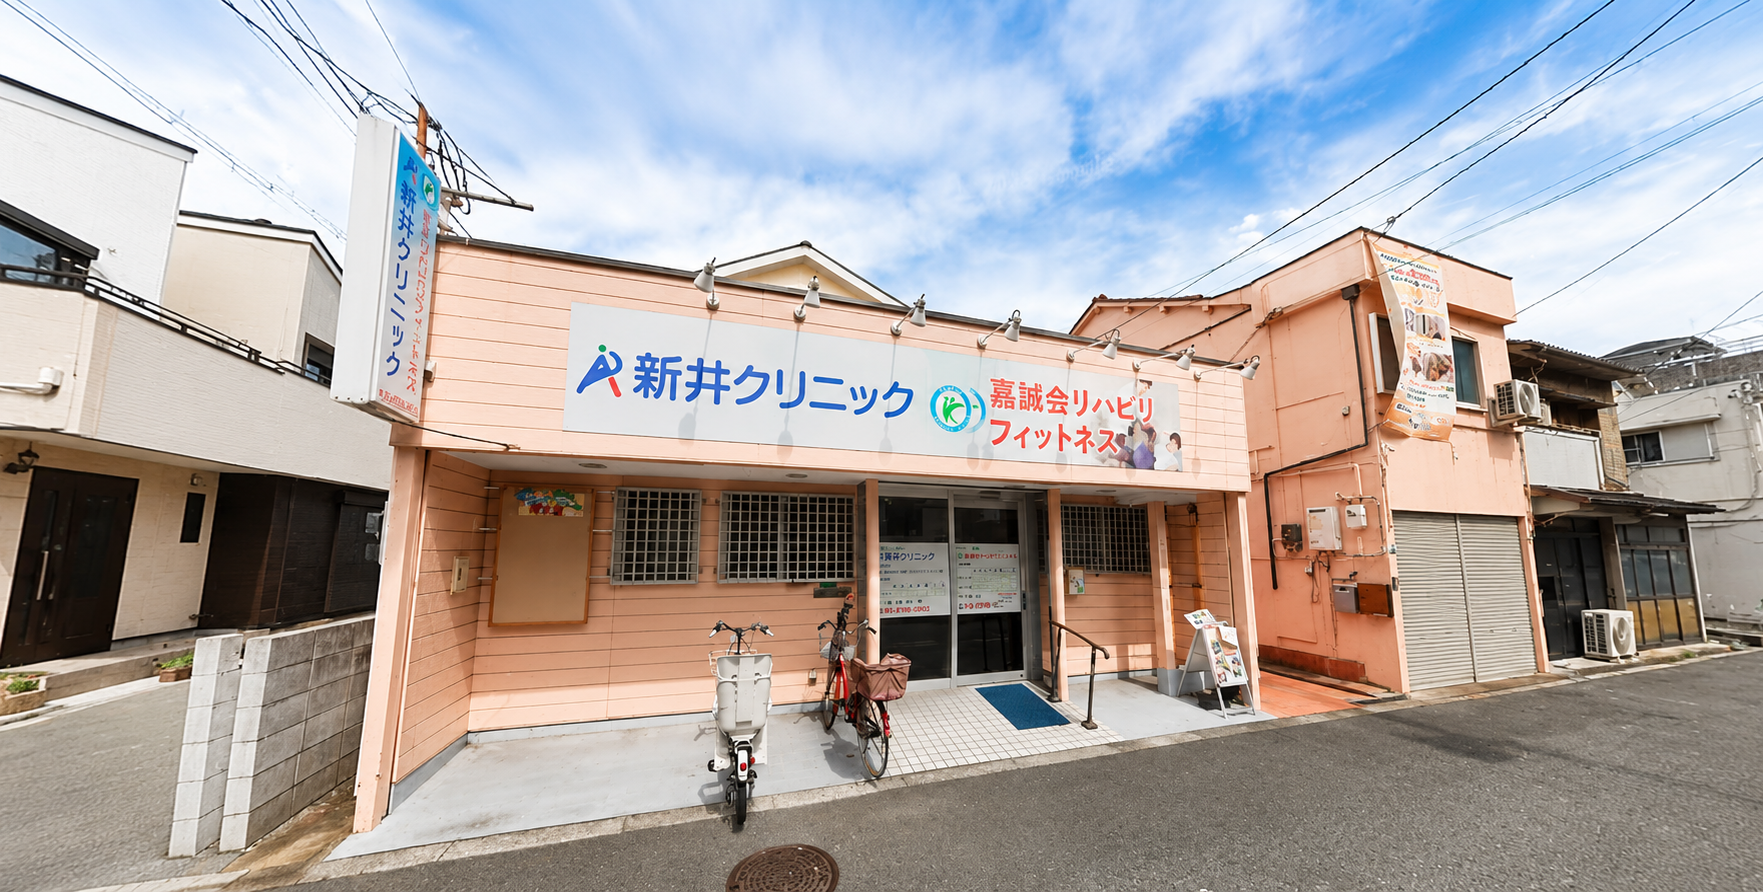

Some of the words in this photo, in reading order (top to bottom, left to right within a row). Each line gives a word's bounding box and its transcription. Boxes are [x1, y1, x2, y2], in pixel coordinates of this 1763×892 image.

[633, 352, 914, 419] 新井クリニック
[990, 378, 1154, 423] 嘉誠会リハビリ
[990, 419, 1118, 454] フィットネス
